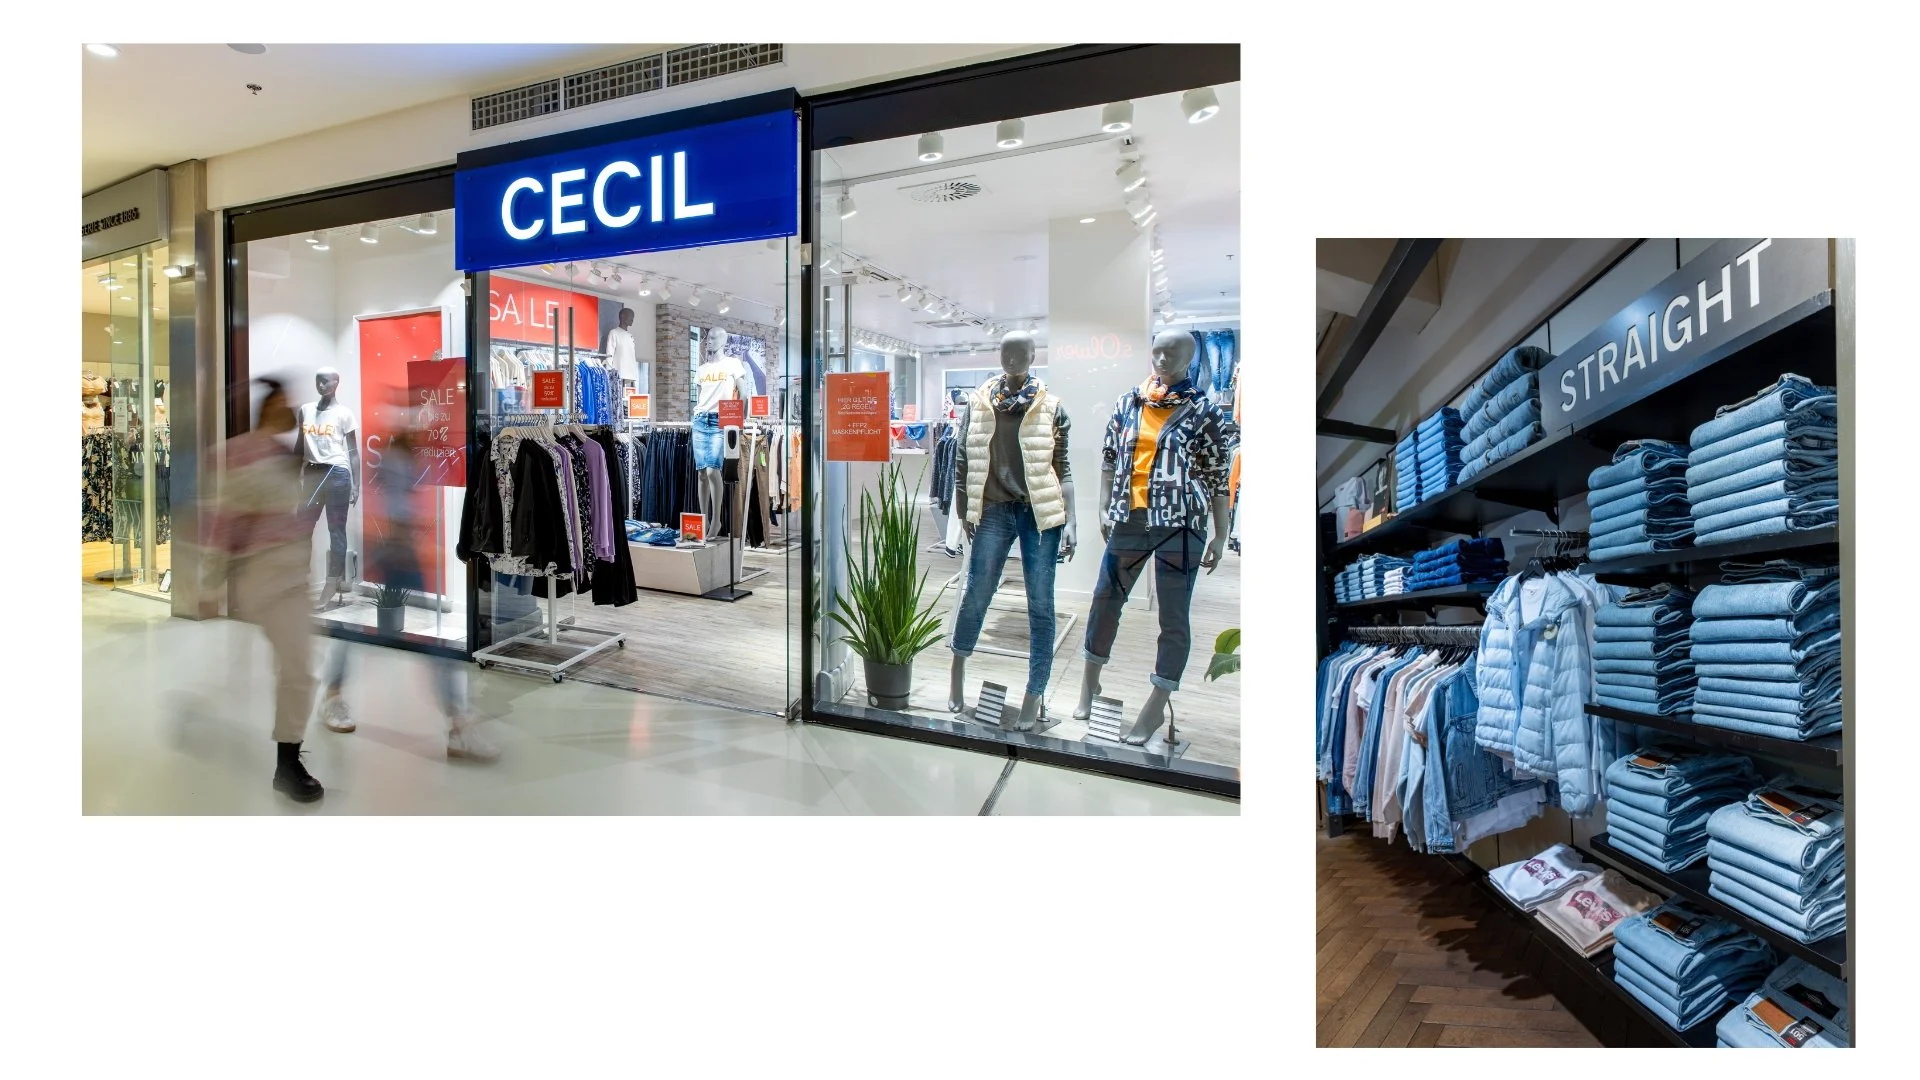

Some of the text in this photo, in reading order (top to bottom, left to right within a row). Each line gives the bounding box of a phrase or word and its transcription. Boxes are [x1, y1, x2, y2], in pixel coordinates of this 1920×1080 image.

[501, 151, 715, 240] CECIL
[489, 289, 559, 329] SALE
[1560, 237, 1772, 413] STRAIGHT
[420, 388, 455, 406] SALE
[427, 426, 449, 442] 70%
[685, 523, 702, 531] SALE
